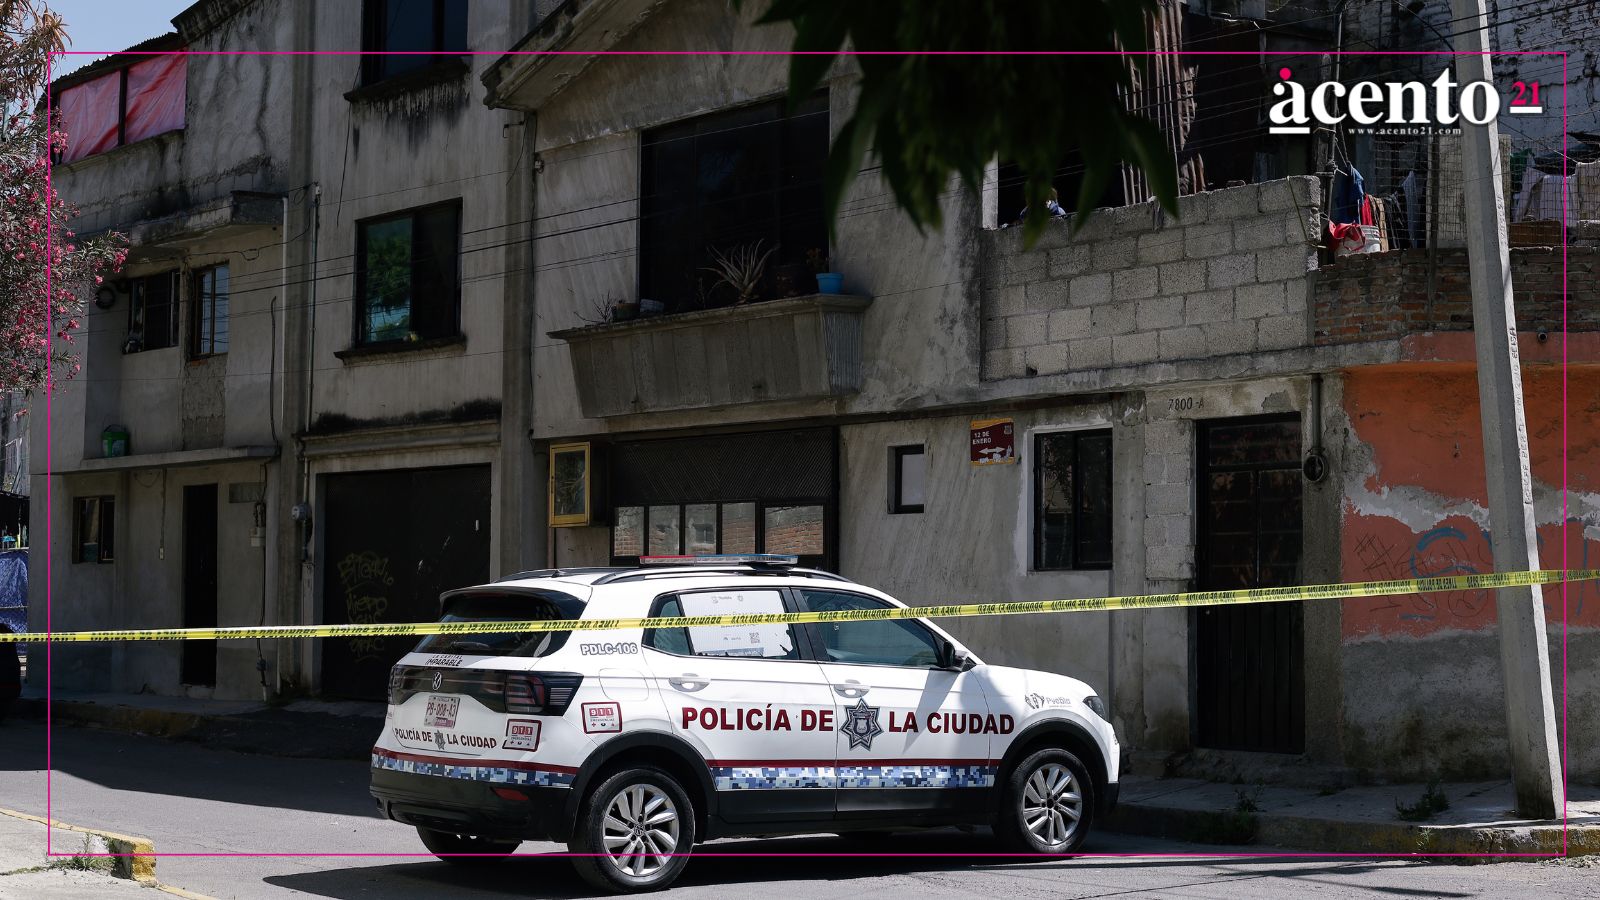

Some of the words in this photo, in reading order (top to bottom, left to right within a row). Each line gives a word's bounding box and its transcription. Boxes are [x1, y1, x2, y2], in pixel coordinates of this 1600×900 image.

[580, 642, 639, 656] PDLC-106
[590, 708, 614, 717] 911
[682, 703, 792, 732] POLICÍA
[801, 709, 834, 732] DE
[888, 711, 919, 733] LA
[926, 712, 1015, 735] CIUDAD
[512, 726, 533, 735] 911
[394, 727, 422, 742] POLICÍA
[421, 731, 433, 742] DE
[446, 733, 459, 746] LA
[460, 735, 498, 749] CIUDAD
